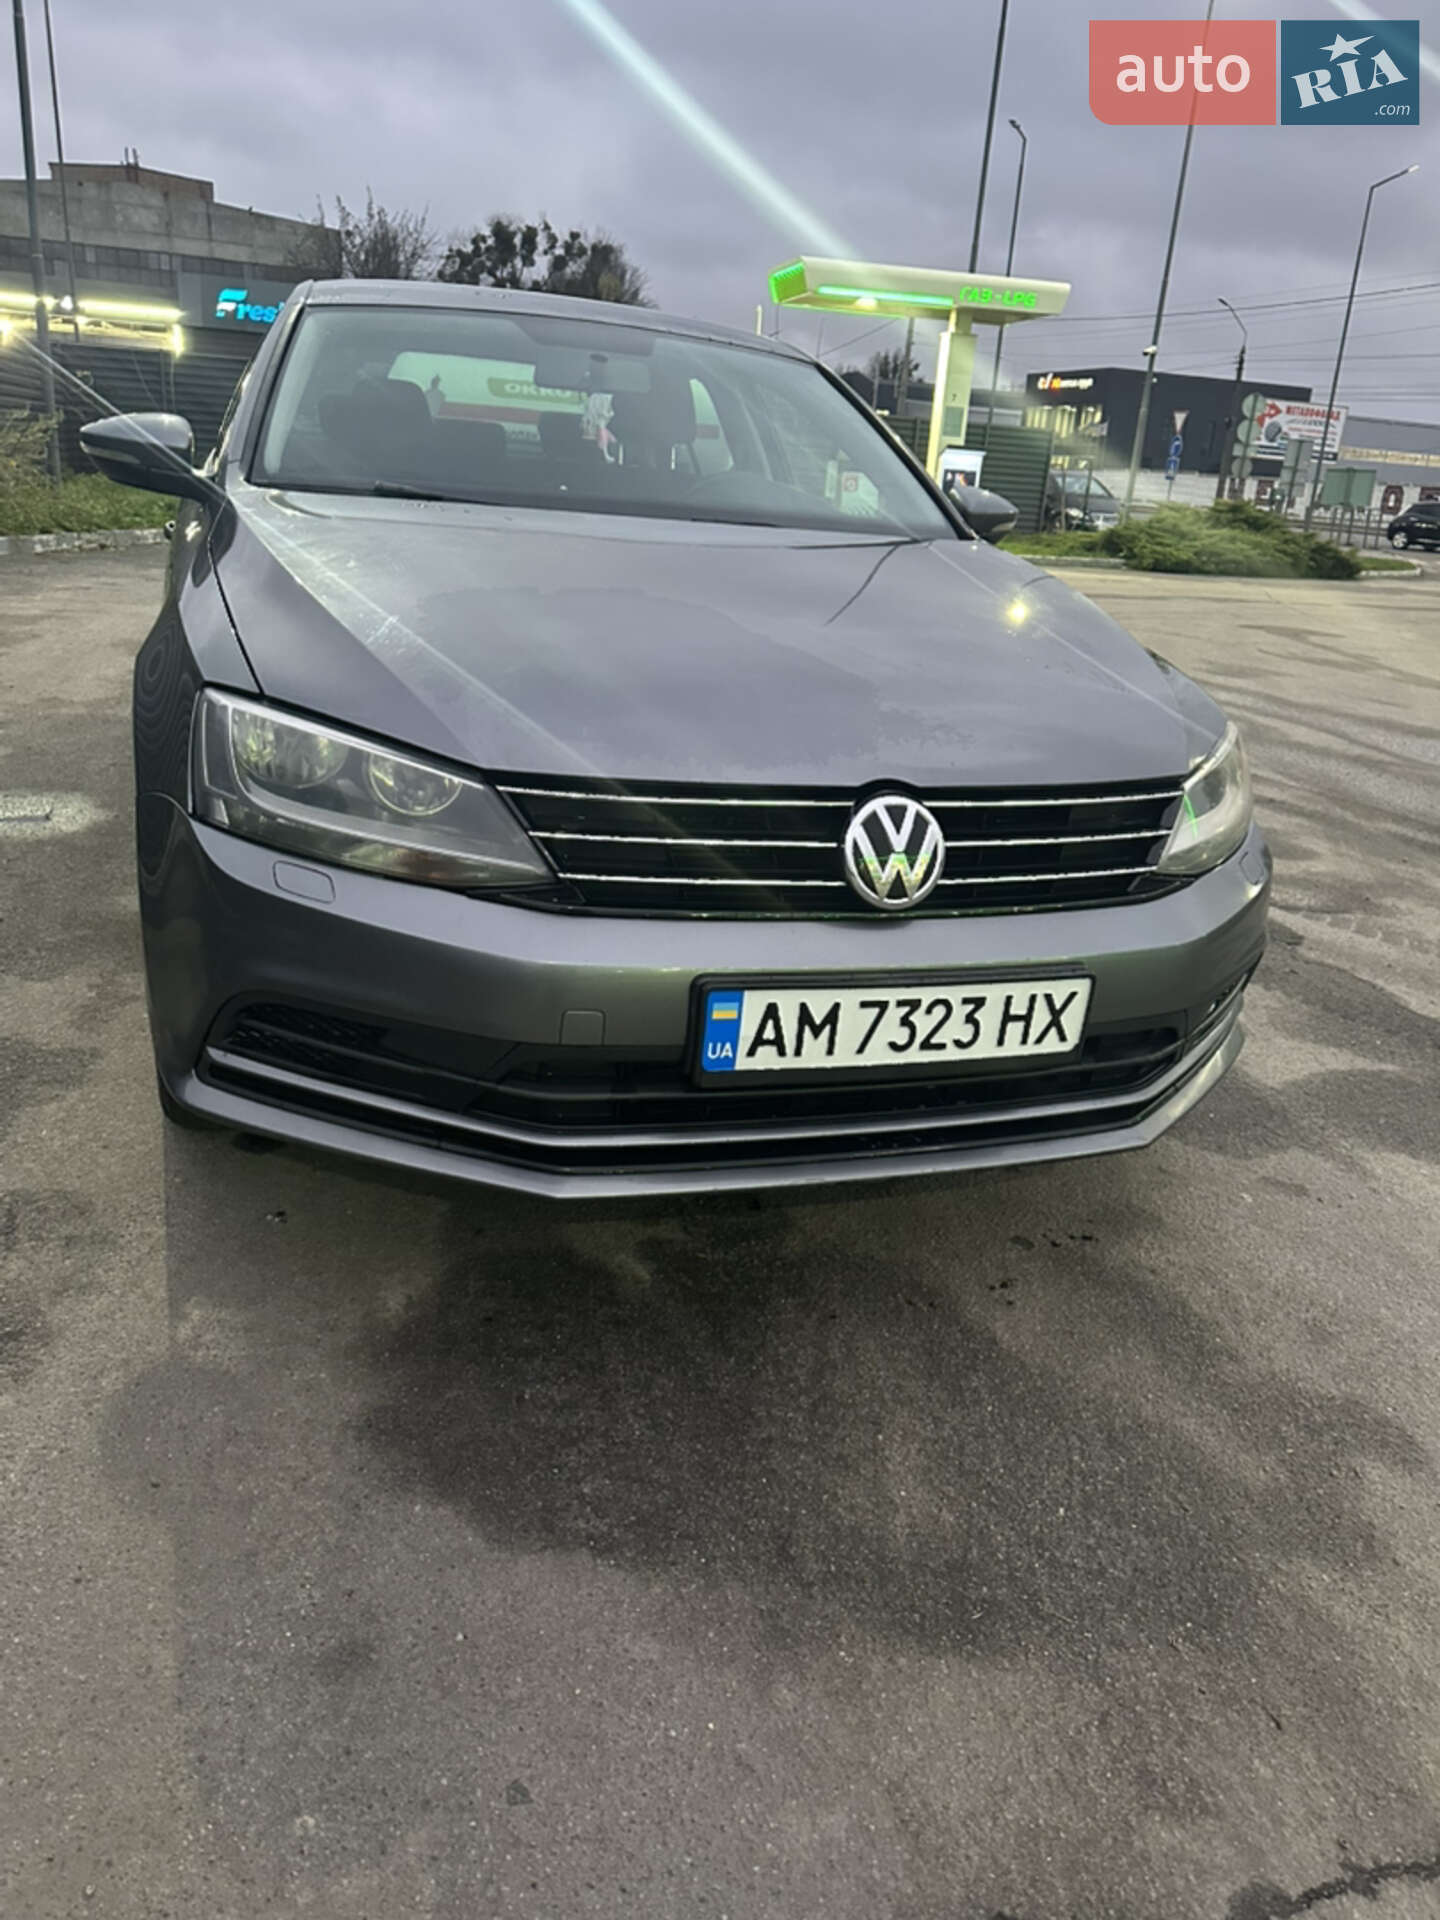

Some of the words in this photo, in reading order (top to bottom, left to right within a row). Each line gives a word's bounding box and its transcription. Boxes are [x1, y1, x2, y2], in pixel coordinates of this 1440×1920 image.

[746, 1001, 841, 1058] AM
[856, 997, 986, 1054] 7323
[997, 991, 1079, 1047] HX
[708, 1042, 733, 1060] UA
